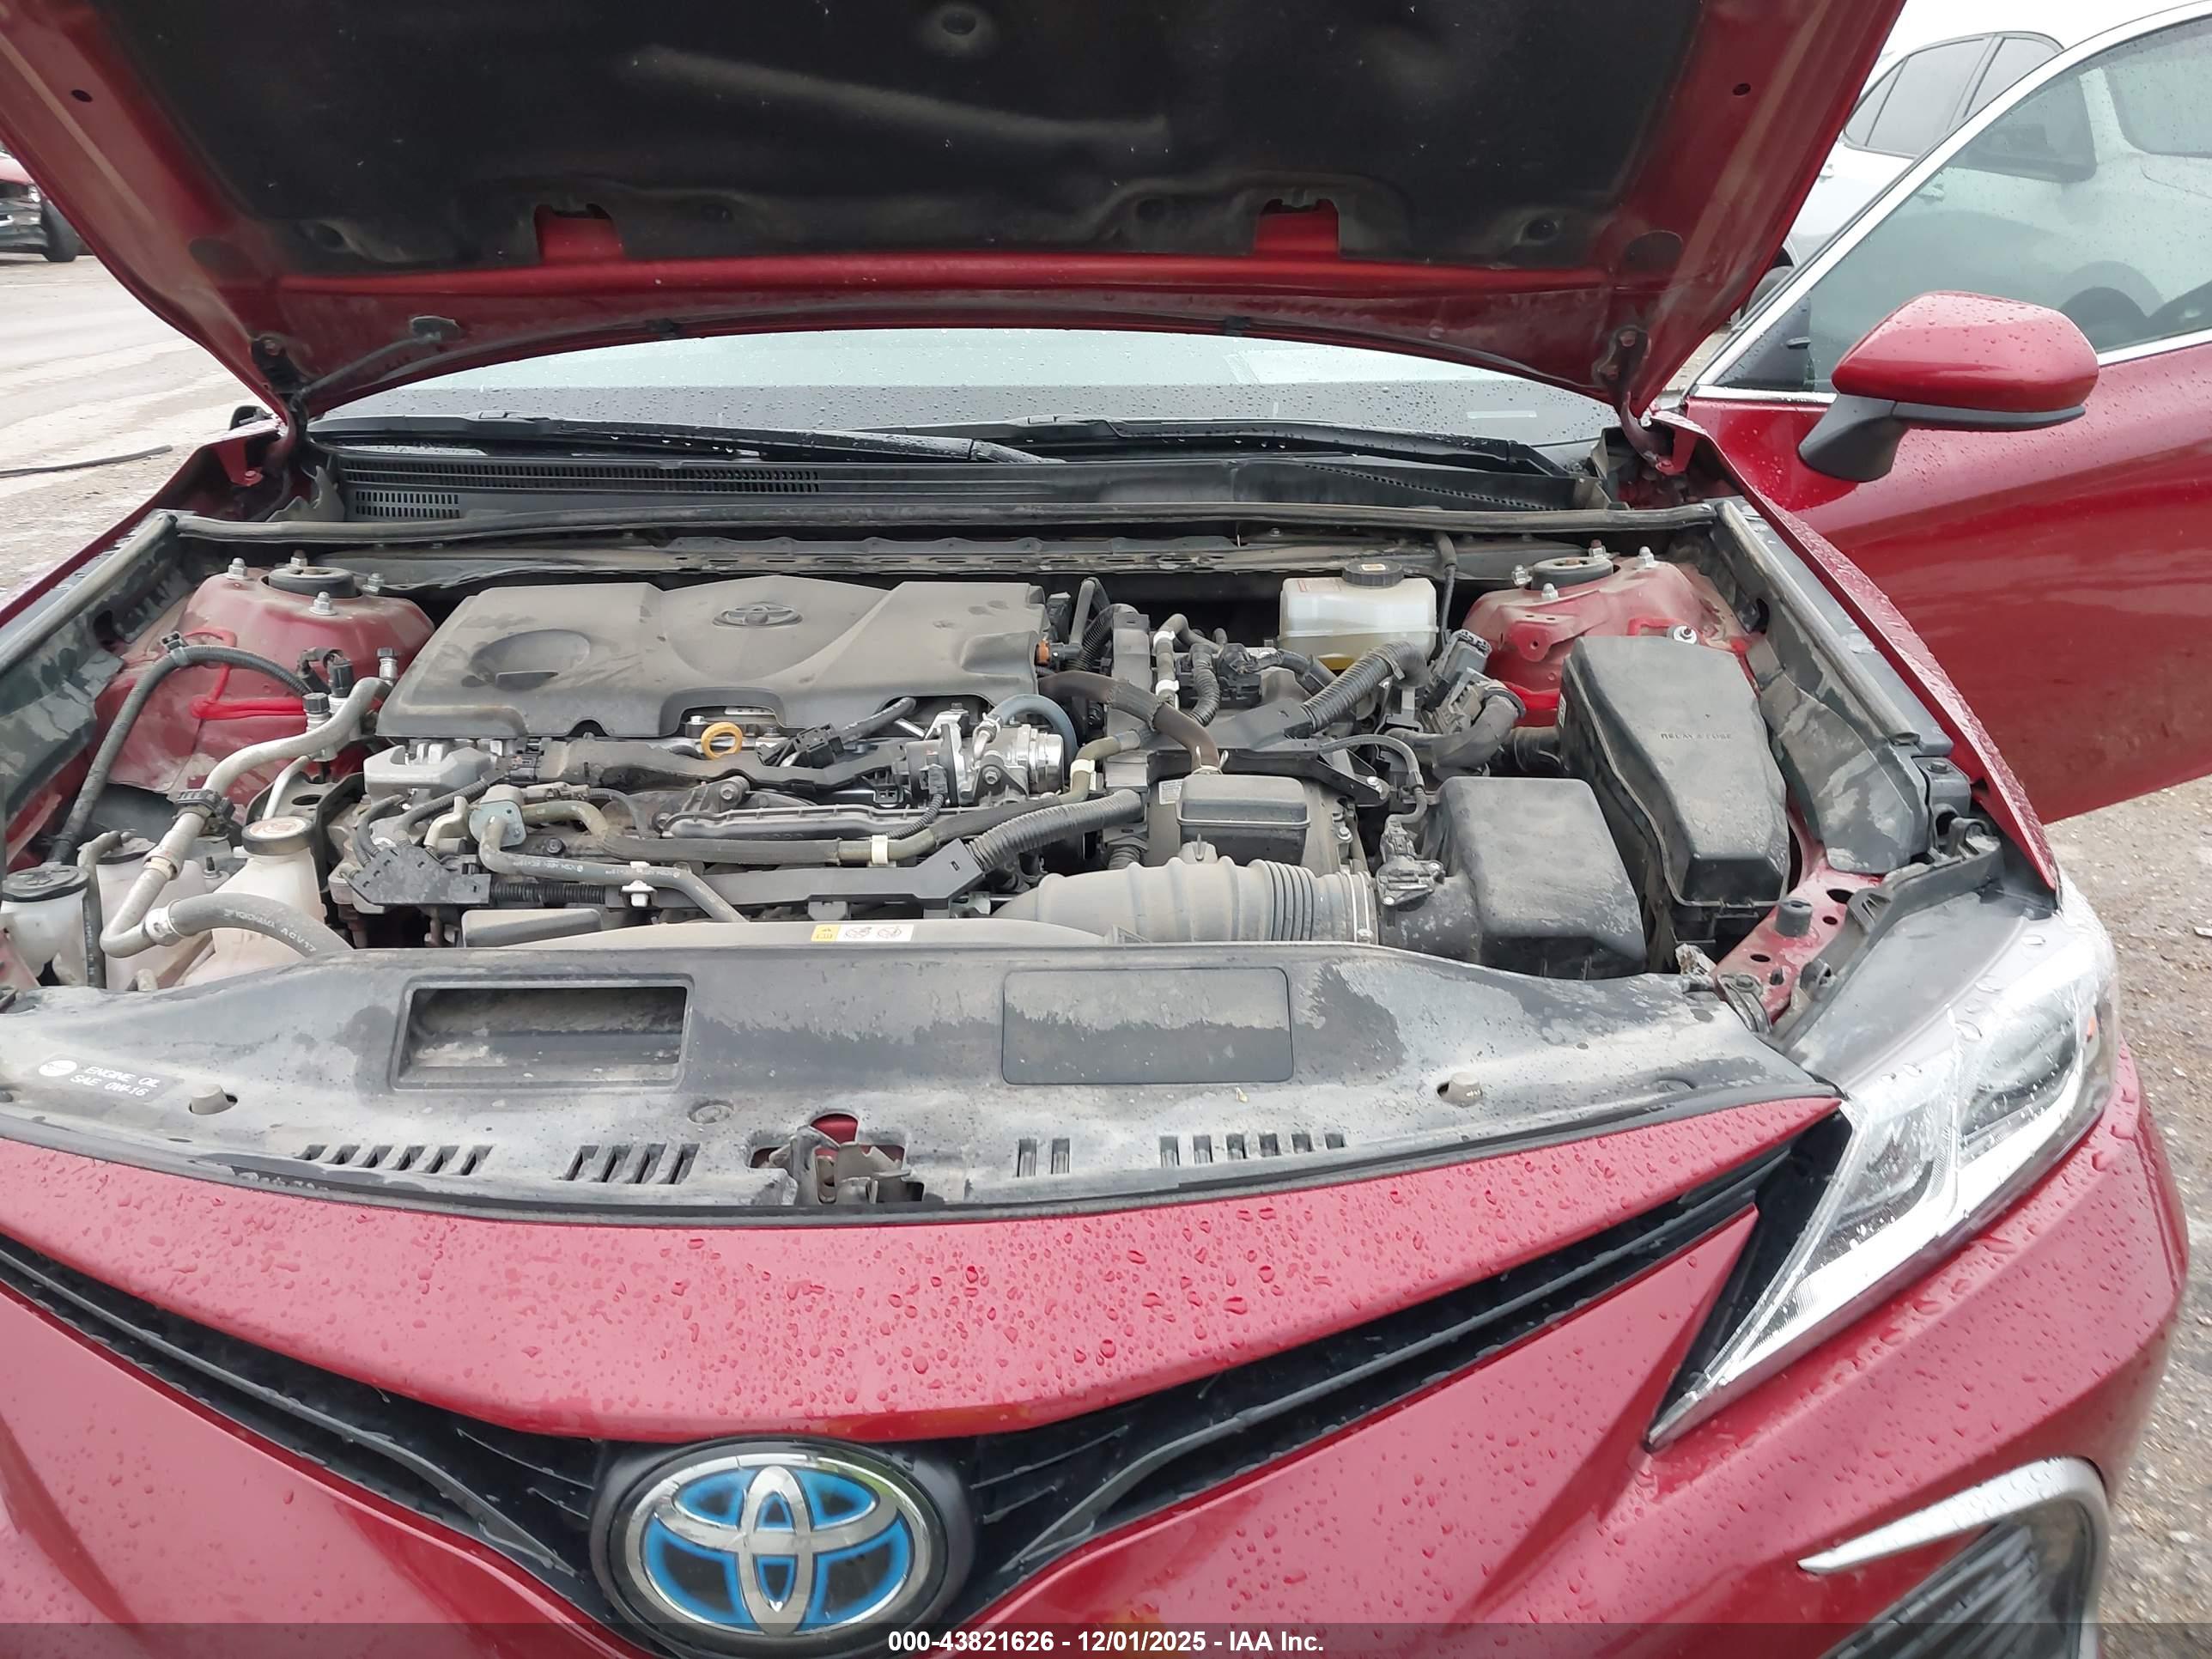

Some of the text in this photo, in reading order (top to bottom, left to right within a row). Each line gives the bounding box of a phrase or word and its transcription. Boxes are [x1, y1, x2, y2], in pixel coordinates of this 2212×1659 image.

[70, 1074, 150, 1097] SAE 0W-16
[84, 1066, 161, 1088] ENGINE OIL
